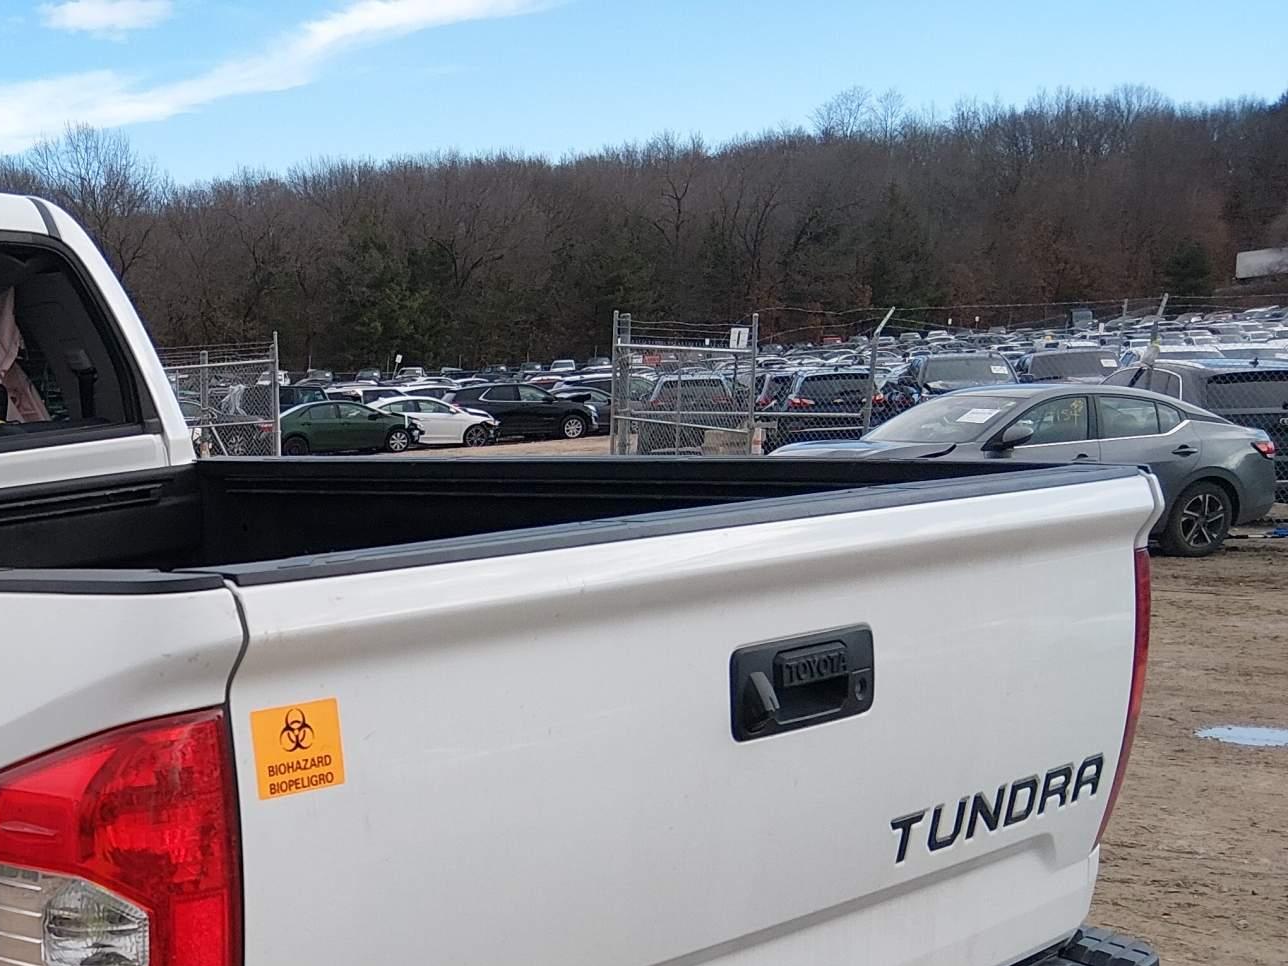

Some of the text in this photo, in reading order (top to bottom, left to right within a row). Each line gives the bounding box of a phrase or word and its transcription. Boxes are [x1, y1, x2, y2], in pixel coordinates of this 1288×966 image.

[784, 651, 848, 684] TOYOTA
[268, 754, 332, 777] BIOHAZARD
[269, 771, 334, 795] BIOPELIGRO
[890, 752, 1104, 864] TUNDRA
